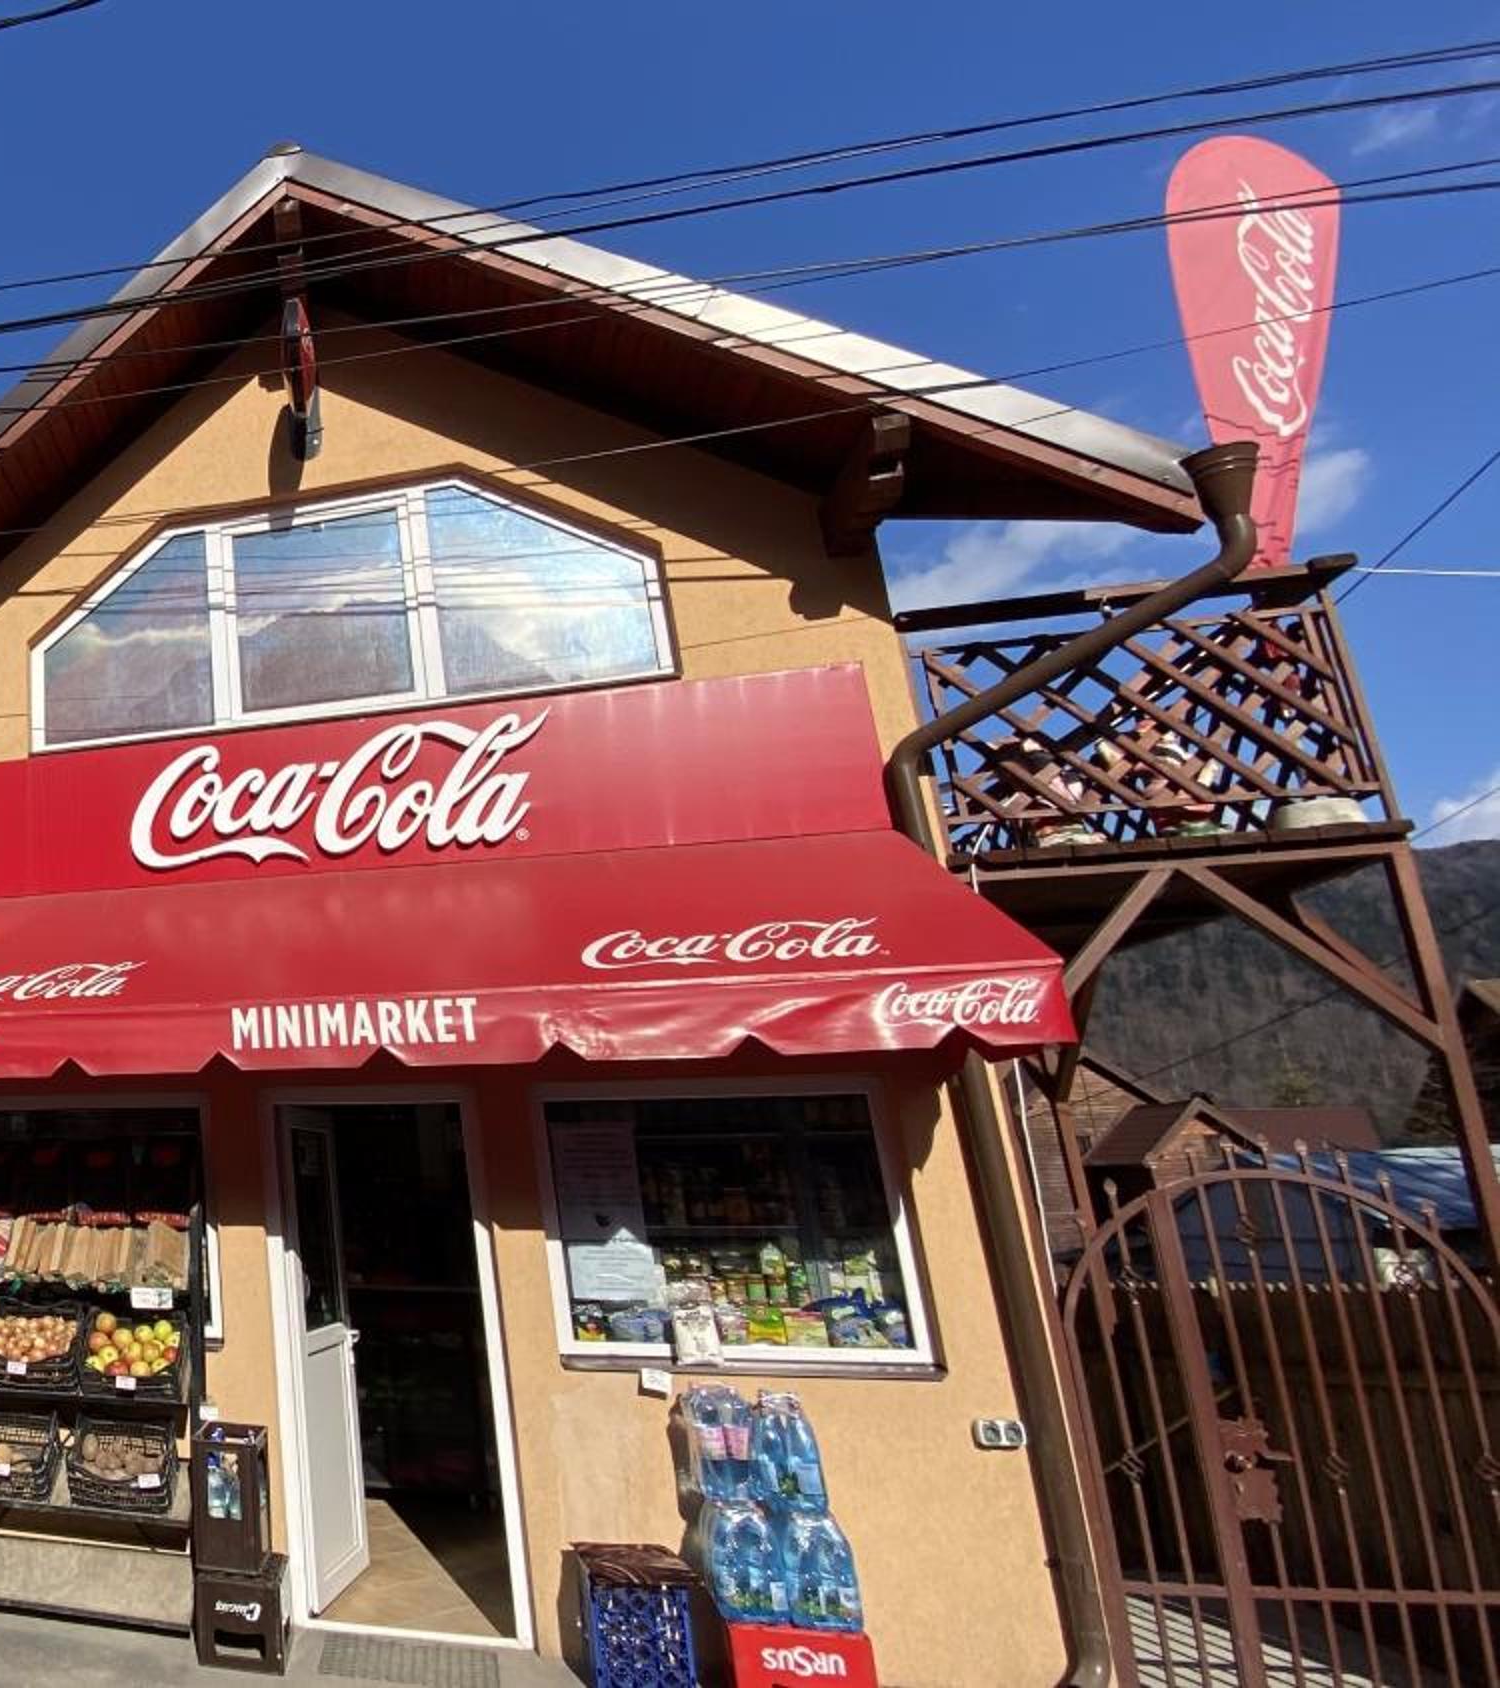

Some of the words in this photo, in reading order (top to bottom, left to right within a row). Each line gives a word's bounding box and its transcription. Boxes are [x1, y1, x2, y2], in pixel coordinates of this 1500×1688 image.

[1232, 177, 1315, 437] Coca-Cola
[130, 704, 551, 869] Coca-Cola
[581, 916, 882, 969] Coca-Cola
[231, 997, 477, 1050] MINIMARKET
[871, 977, 1041, 1026] Coca-Cola
[760, 1645, 847, 1677] URSUS
